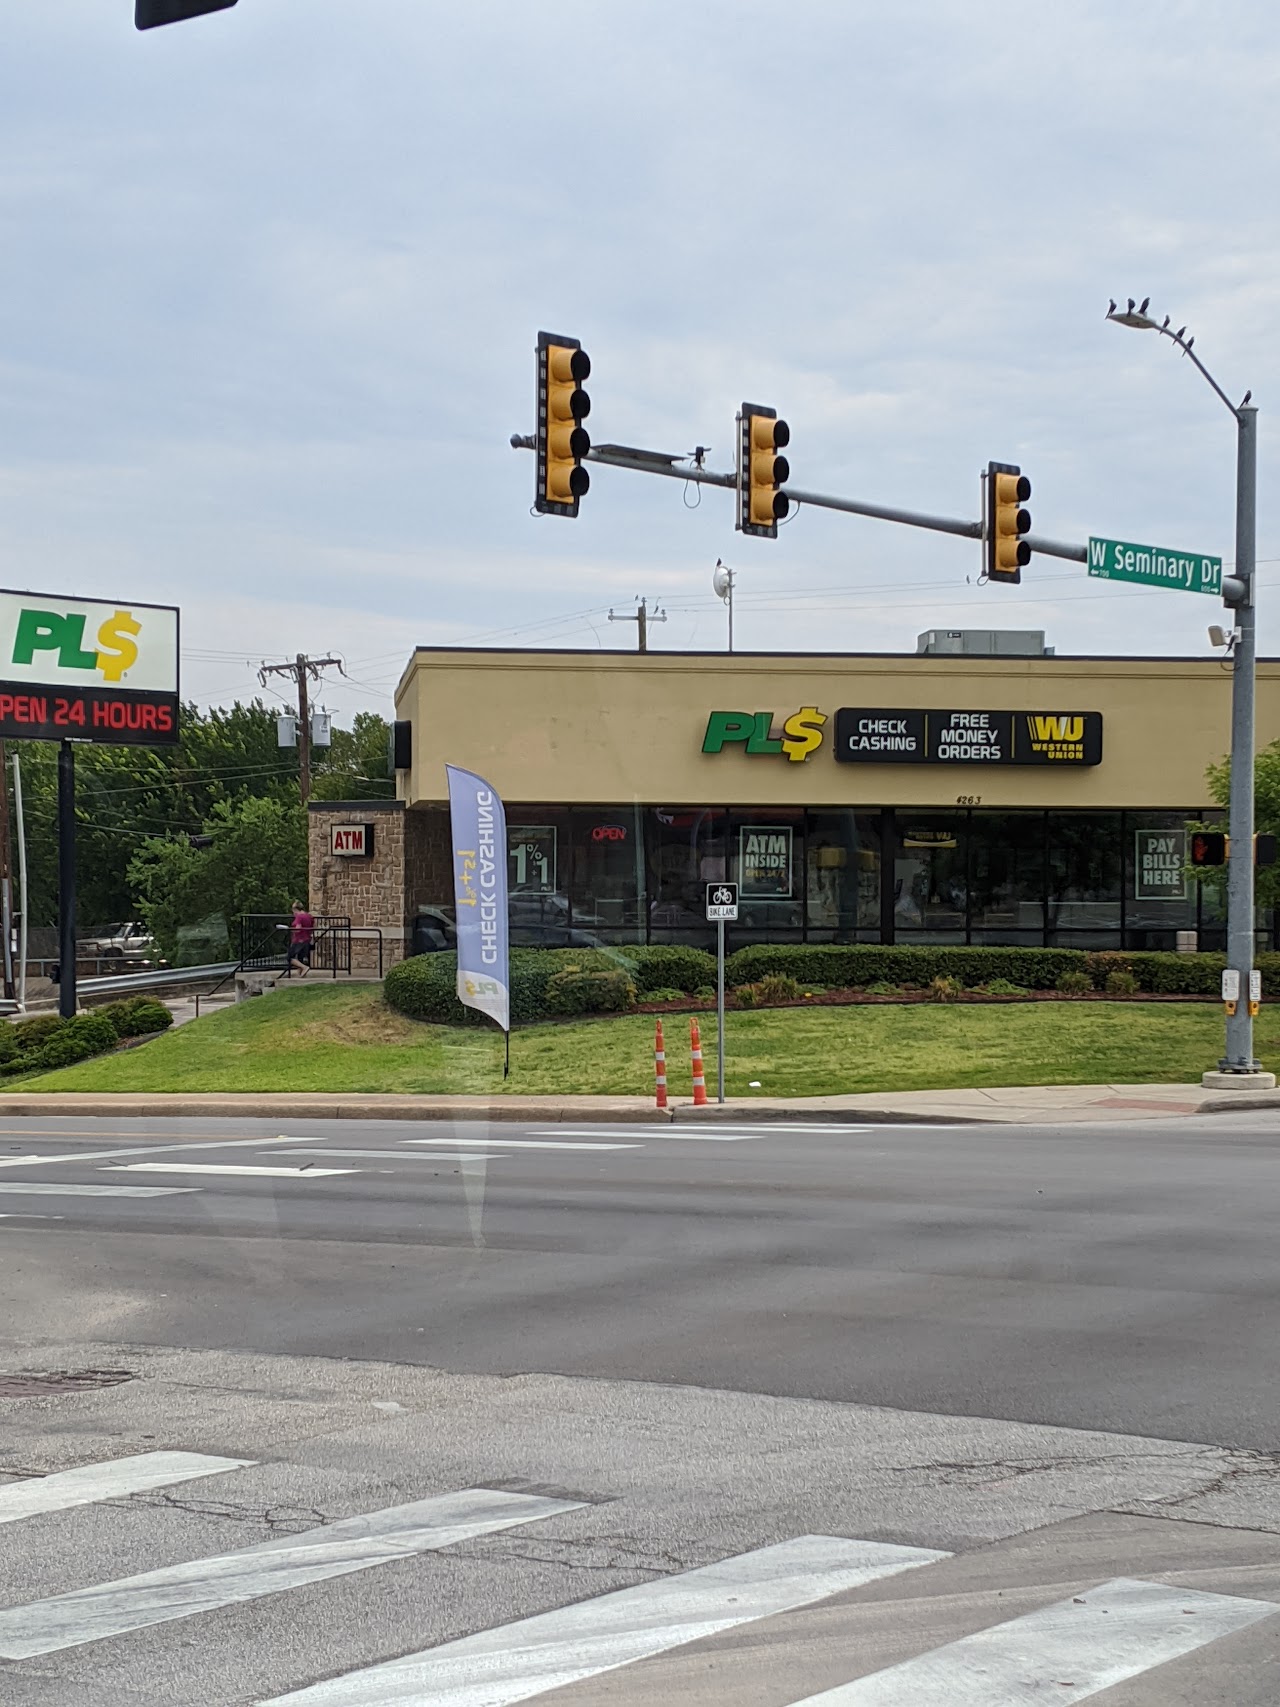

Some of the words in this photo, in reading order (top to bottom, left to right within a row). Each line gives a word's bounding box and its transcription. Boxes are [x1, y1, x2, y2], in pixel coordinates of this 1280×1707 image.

[1091, 540, 1107, 567] W
[1114, 544, 1195, 587] Seminary
[1201, 559, 1220, 584] Dr
[0, 694, 47, 723] PEN
[54, 698, 86, 726] 24
[93, 701, 172, 731] HOURS
[859, 719, 907, 734] CHECK
[951, 714, 990, 728] FREE
[941, 729, 998, 744] MONEY
[1032, 716, 1084, 742] WU
[849, 736, 917, 751] CASHING
[1032, 743, 1084, 751] WESTERN
[938, 745, 1001, 760] ORDERS
[1048, 752, 1084, 760] UNION
[334, 831, 363, 850] ATM
[592, 827, 625, 840] OPEN
[746, 835, 787, 853] ATM
[1147, 838, 1177, 853] PAY
[745, 854, 787, 868] INSIDE
[1143, 854, 1181, 869] BILLS
[1143, 870, 1181, 885] HERE
[709, 908, 721, 916] BIKE
[722, 907, 735, 916] LANE
